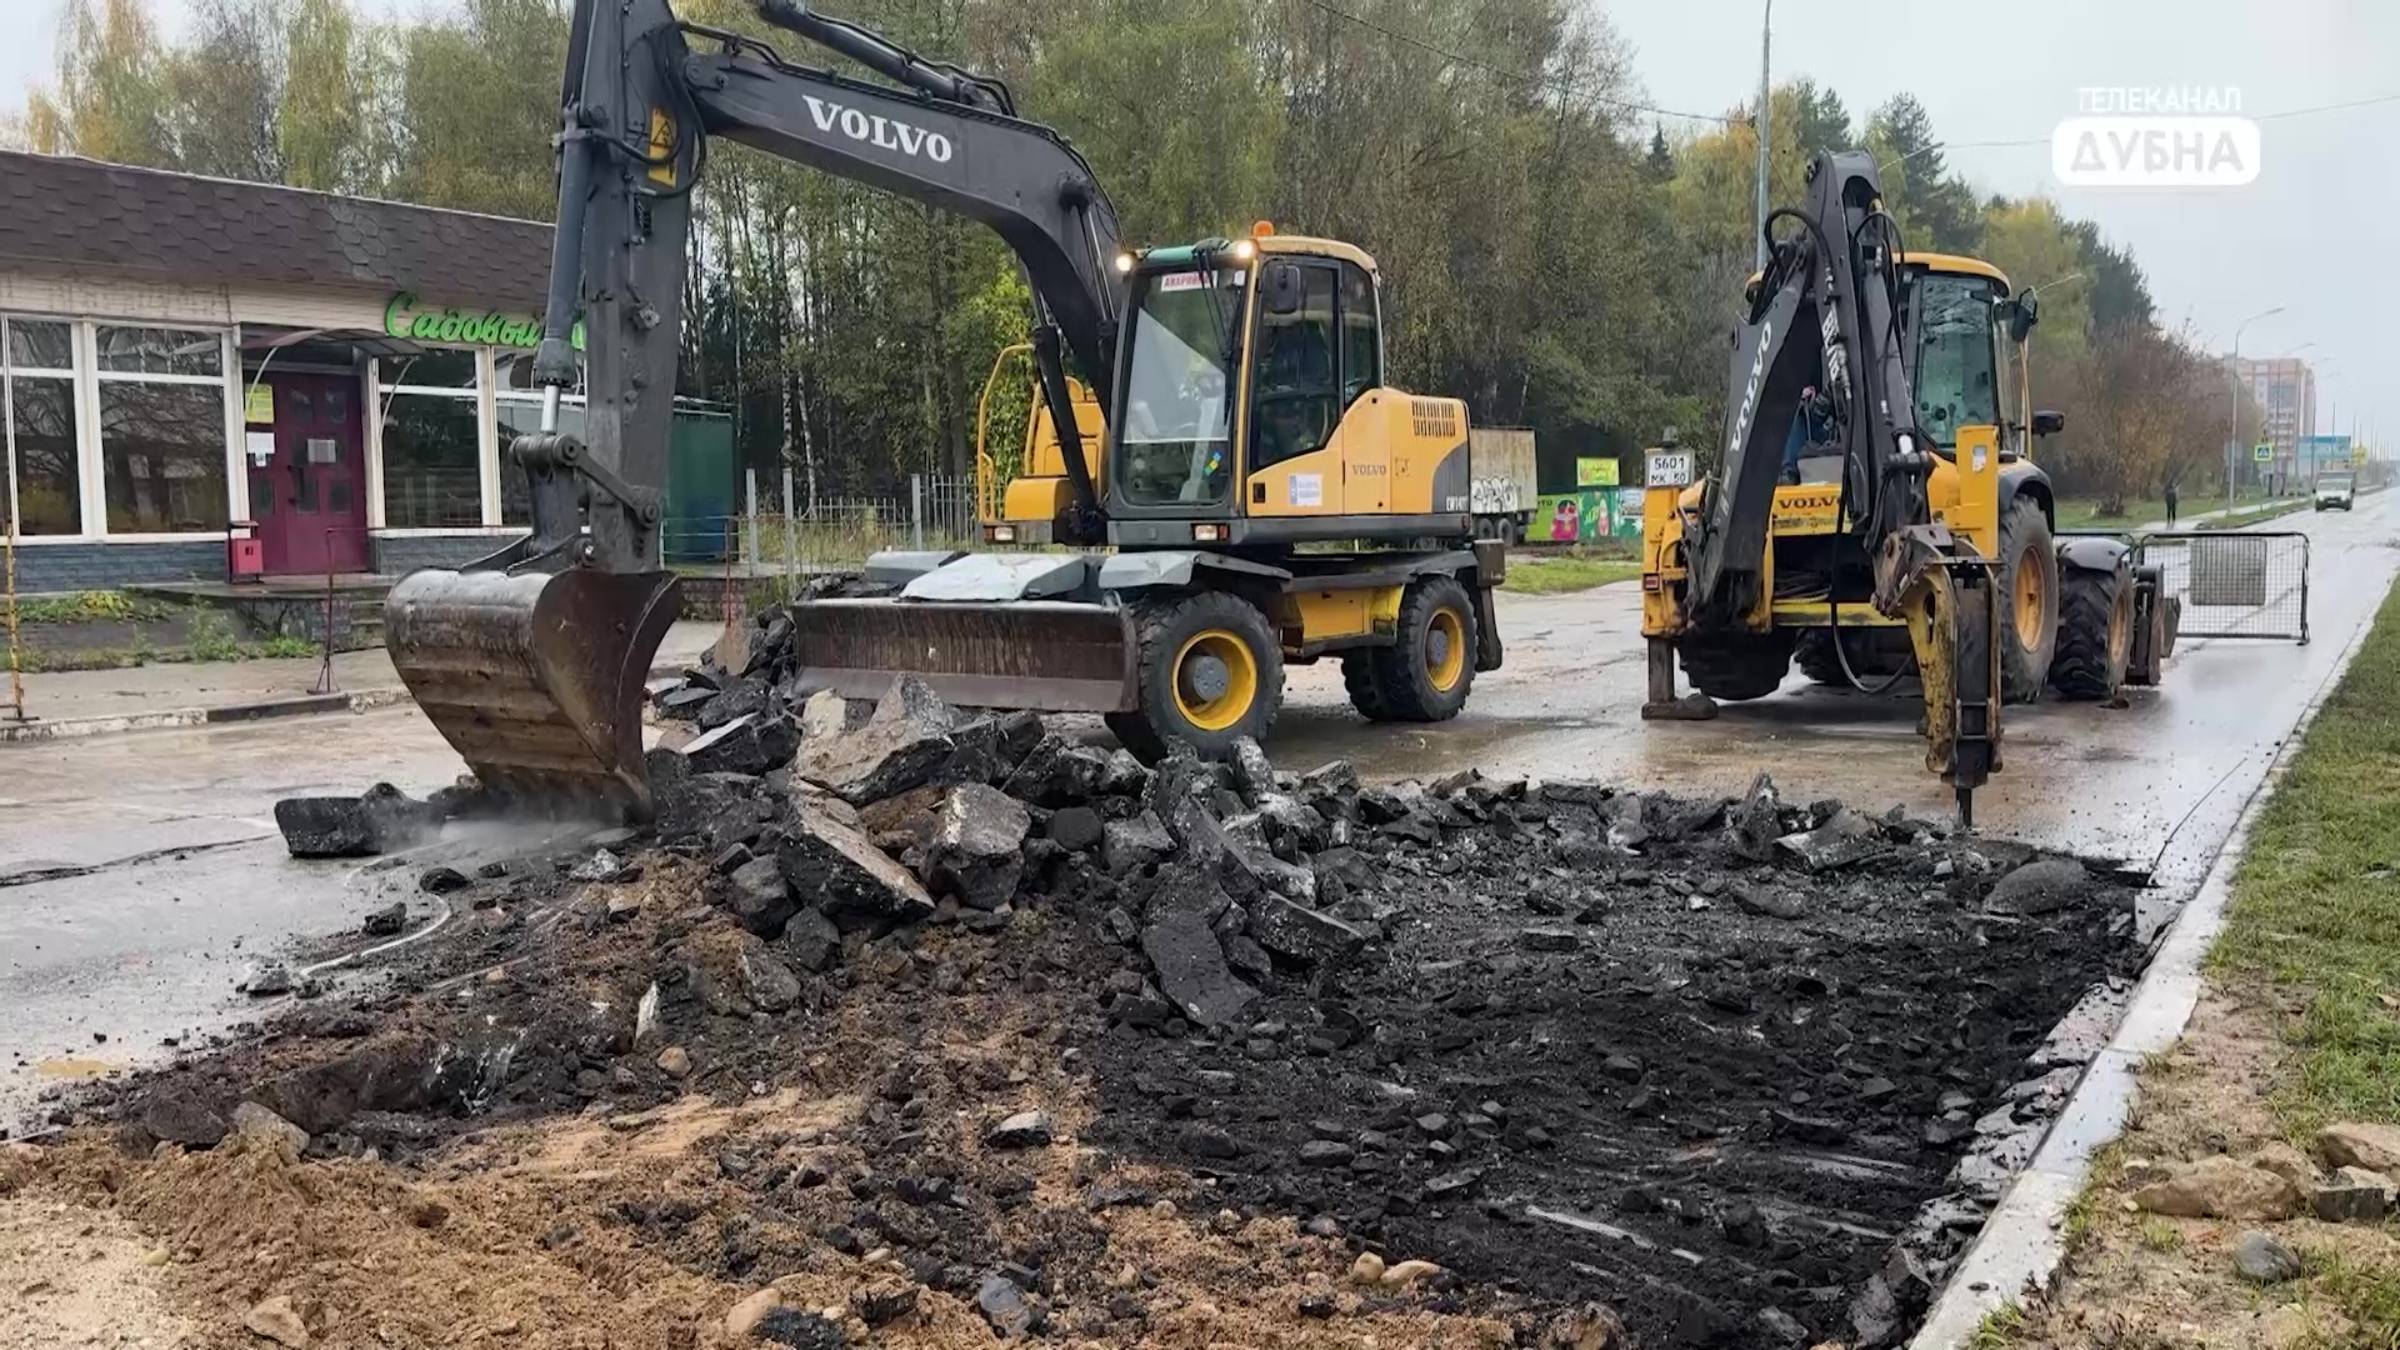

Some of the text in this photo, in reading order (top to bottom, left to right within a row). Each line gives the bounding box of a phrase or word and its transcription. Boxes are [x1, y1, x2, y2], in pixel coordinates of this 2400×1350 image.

[802, 94, 953, 163] VOLVO
[1730, 321, 1773, 451] VOLVO
[1352, 464, 1387, 476] VOLVO
[1655, 457, 1685, 470] 5601
[1778, 496, 1841, 509] VOLV
